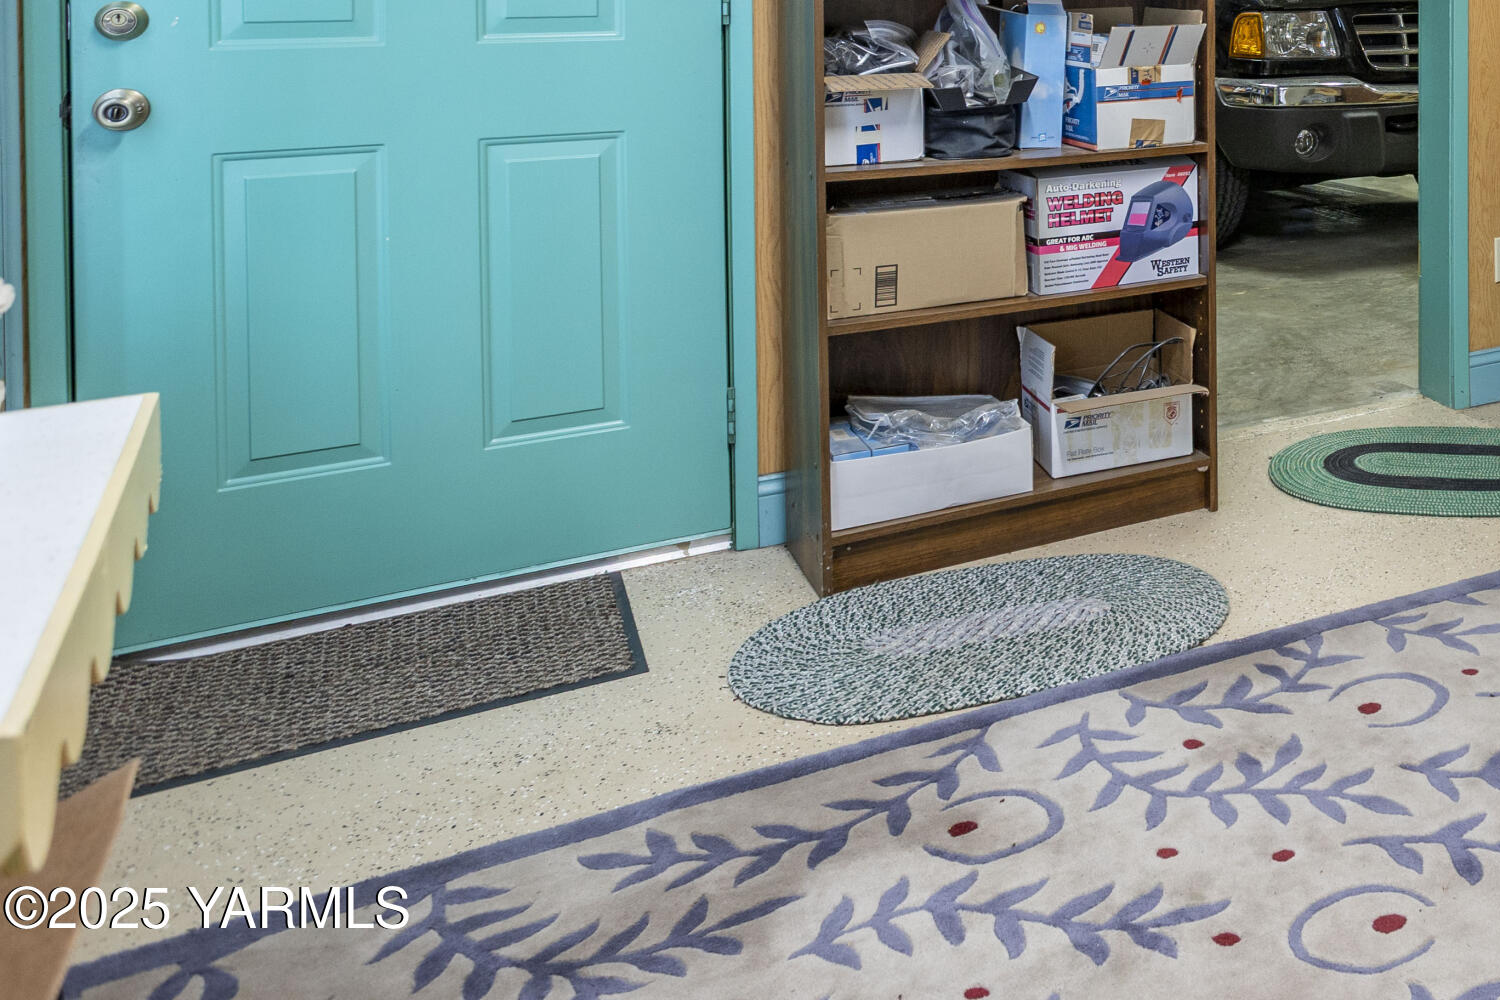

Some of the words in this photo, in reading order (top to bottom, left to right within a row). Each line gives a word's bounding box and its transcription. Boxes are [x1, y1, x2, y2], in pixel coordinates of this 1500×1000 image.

[1045, 178, 1122, 193] Auto-Darkening
[1046, 190, 1124, 212] WELDING
[1047, 208, 1114, 228] HELMET
[1046, 235, 1067, 245] GREAT
[1067, 235, 1081, 243] FOR
[1078, 241, 1107, 249] WELDING
[1150, 257, 1191, 270] WESTERN
[1157, 266, 1189, 277] SAFETY
[1083, 412, 1112, 420] PRIORITY
[1082, 419, 1098, 427] MAIL
